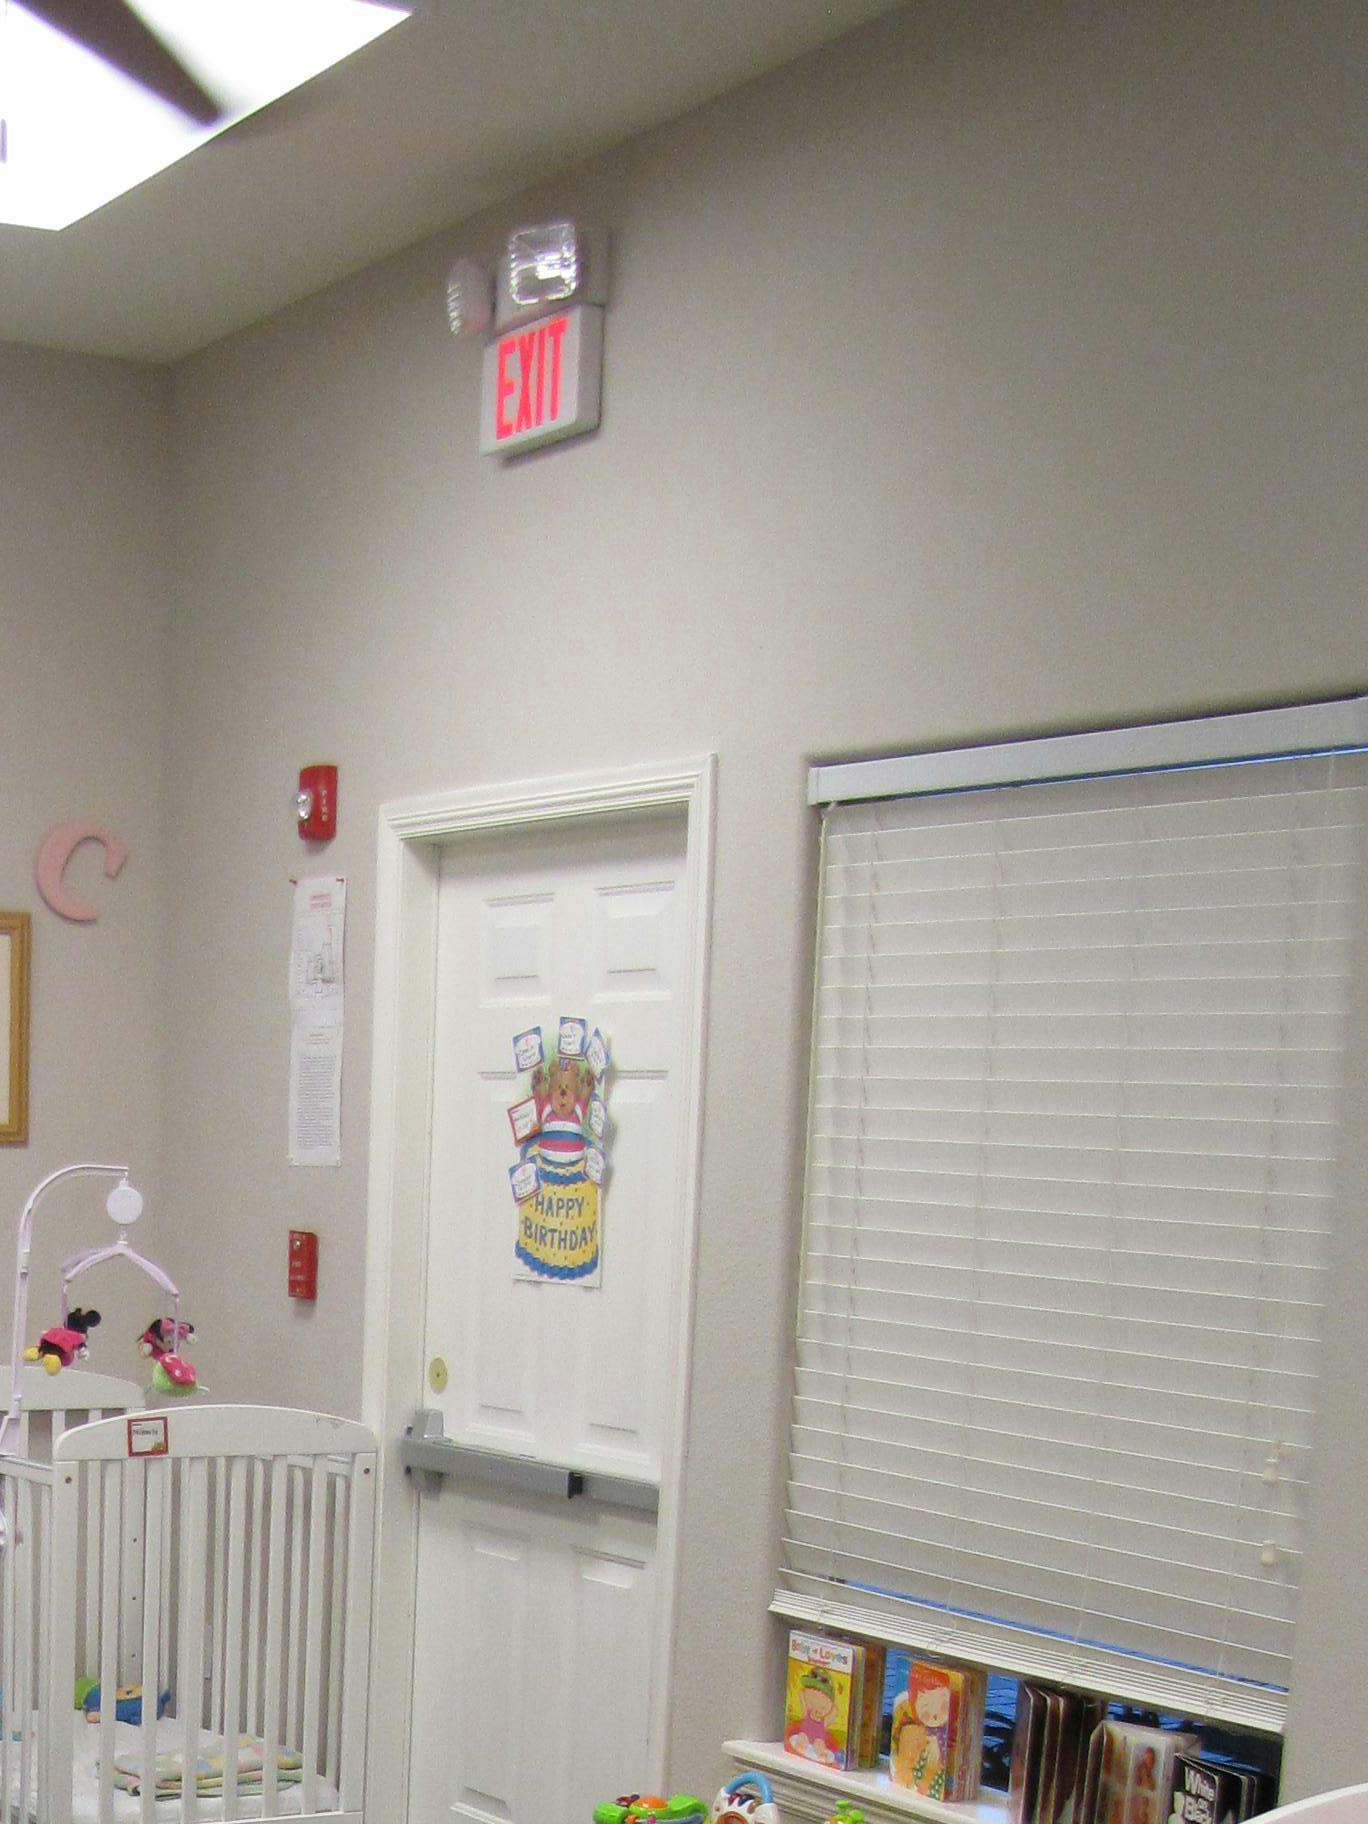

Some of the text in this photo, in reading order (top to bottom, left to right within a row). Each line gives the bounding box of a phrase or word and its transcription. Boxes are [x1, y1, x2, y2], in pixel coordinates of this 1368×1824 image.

[495, 316, 568, 440] EXIT
[36, 822, 128, 923] C
[524, 1216, 595, 1250] BIRTHDAY
[535, 1196, 585, 1219] HAPPY
